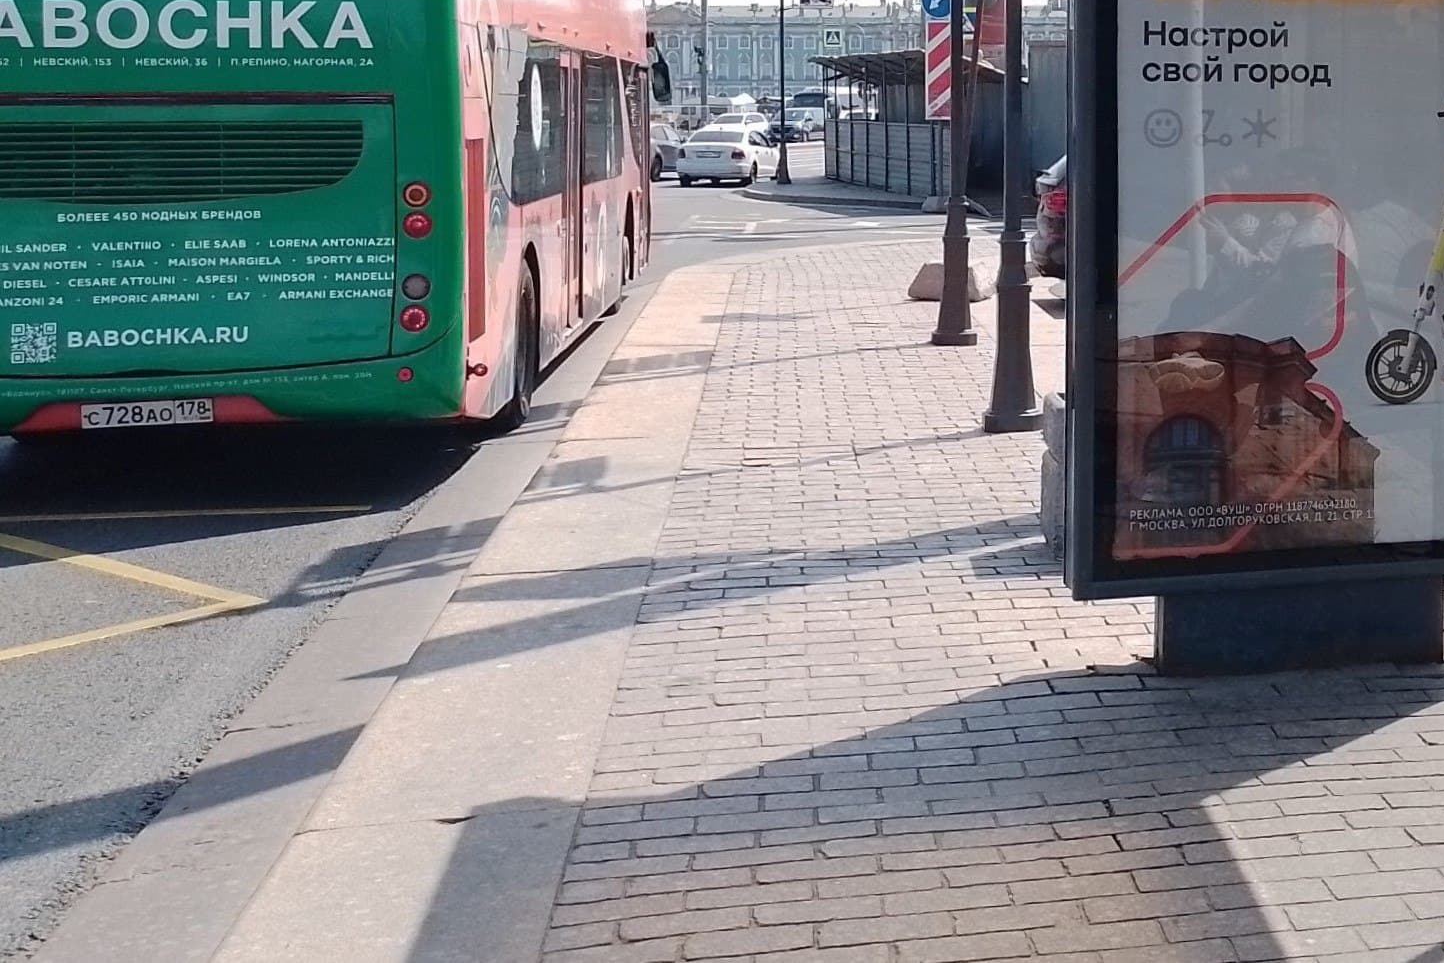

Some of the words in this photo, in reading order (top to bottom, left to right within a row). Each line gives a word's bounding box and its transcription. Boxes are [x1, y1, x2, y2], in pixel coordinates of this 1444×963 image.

[1144, 20, 1289, 53] Настрой
[95, 58, 112, 67] 153
[195, 58, 208, 67] 36
[1142, 55, 1223, 83] свой
[1233, 62, 1332, 89] город
[113, 211, 138, 221] 450
[201, 210, 261, 221] БРЕНДОВ
[15, 243, 67, 253] SANDER
[91, 241, 161, 251] VALENTINO
[184, 240, 210, 250] ELIE
[213, 239, 246, 249] SAAB
[269, 238, 318, 248] LORENA
[321, 237, 395, 248] ANTONIAZZI
[12, 261, 40, 271] VAN
[44, 260, 87, 270] NOTEN
[112, 259, 145, 269] ISAIA
[168, 256, 216, 268] MAISON
[219, 255, 281, 266] MARGIELA
[306, 255, 352, 265] SPORTY
[355, 255, 363, 264] &
[367, 253, 394, 264] RICH
[3, 279, 47, 290] DIESEL
[68, 277, 117, 287] CESARE
[120, 275, 176, 286] ATTOLINI
[196, 274, 238, 284] ASPESI
[257, 272, 315, 283] WINDSOR
[335, 271, 395, 281] MANDELLI
[48, 296, 64, 306] 24
[150, 292, 200, 303] ARMANI
[227, 291, 251, 301] EA7
[278, 290, 326, 300] ARMANI
[329, 288, 393, 299] EXCHANGE
[66, 325, 249, 348] BABOCHKA.RU
[176, 401, 206, 416] 178
[1188, 506, 1213, 517] ООО
[1255, 501, 1283, 514] ОГРН
